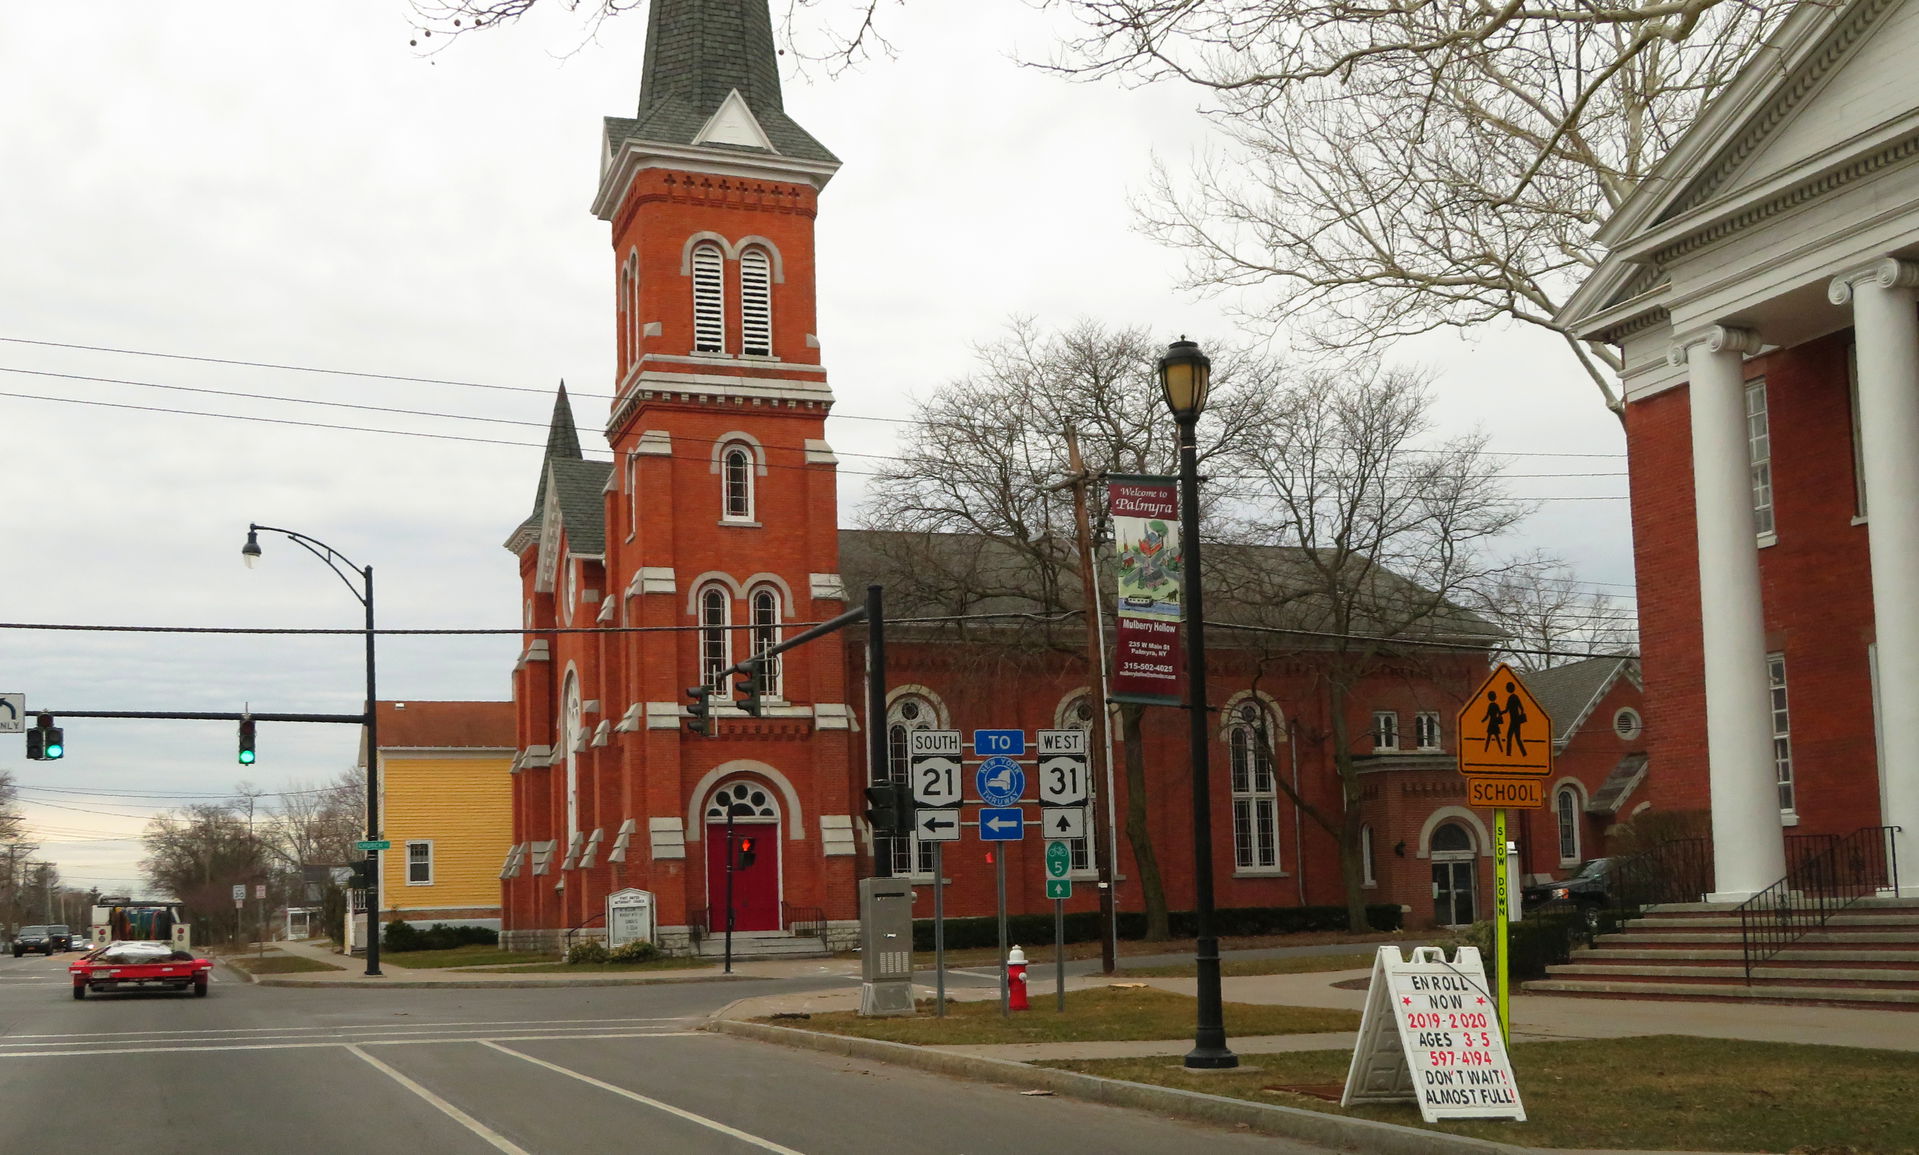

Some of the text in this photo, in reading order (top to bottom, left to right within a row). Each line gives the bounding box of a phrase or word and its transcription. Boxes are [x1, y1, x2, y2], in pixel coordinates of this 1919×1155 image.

[1120, 487, 1168, 498] Welcome to
[1115, 497, 1173, 518] Palmyra
[1122, 618, 1176, 633] Mulberry Hollow
[1131, 648, 1158, 657] Palmyra,
[1141, 641, 1148, 649] W
[1123, 661, 1174, 673] 315-502-4025
[0, 721, 20, 730] NLY
[915, 735, 958, 750] SOUTH
[988, 735, 1011, 750] TO
[1043, 735, 1079, 749] WEST
[980, 758, 1021, 775] NEW YORK
[922, 767, 953, 796] 21
[1049, 767, 1078, 795] 31
[982, 790, 1019, 805] THRUWAY
[1473, 783, 1539, 802] SCHOOL
[1054, 861, 1063, 874] 5
[1497, 826, 1506, 916] SLOW DOWN
[1411, 975, 1469, 991] ENROLL
[1428, 994, 1463, 1010] NOW
[1419, 1032, 1453, 1048] AGES
[1429, 1050, 1492, 1067] 597-4194
[1425, 1069, 1507, 1086] DON'T WAIT!
[1425, 1088, 1516, 1105] ALMOST FULL!
